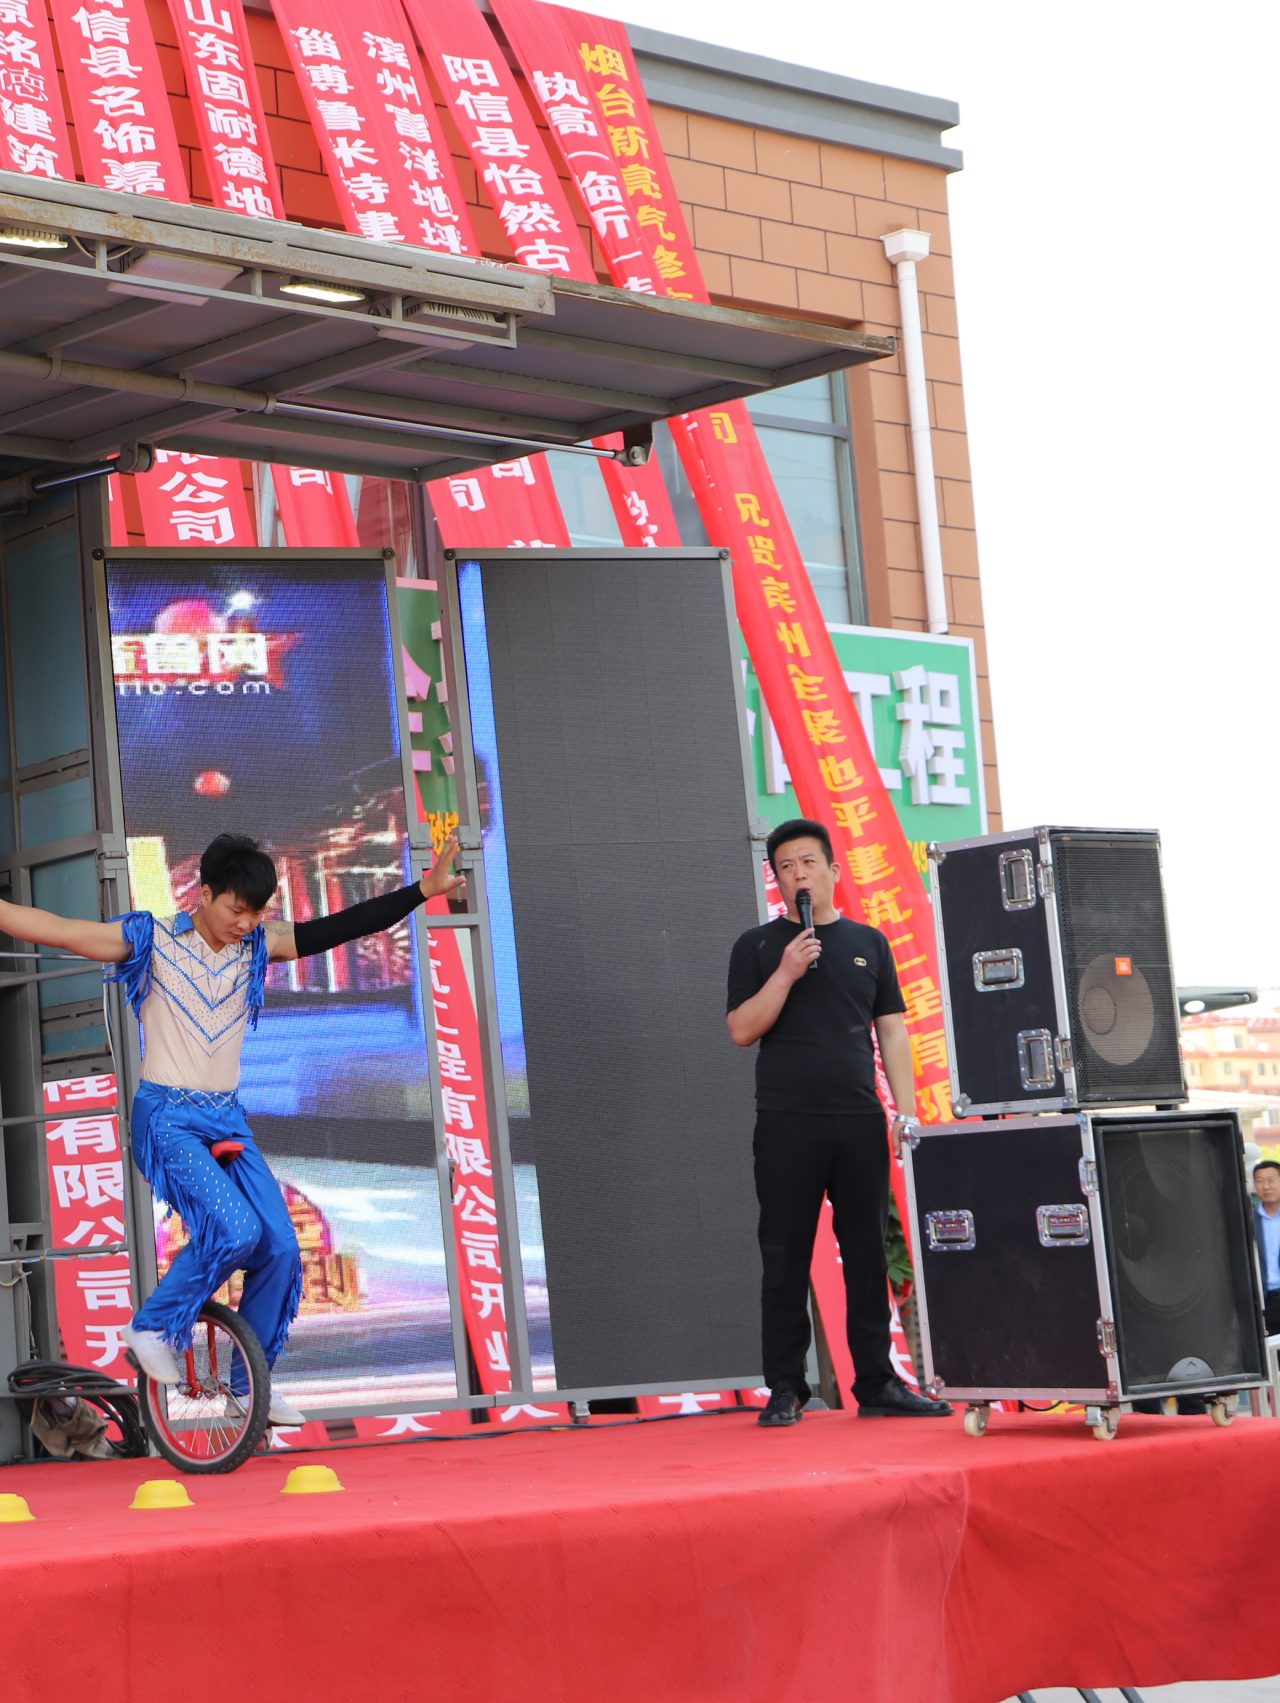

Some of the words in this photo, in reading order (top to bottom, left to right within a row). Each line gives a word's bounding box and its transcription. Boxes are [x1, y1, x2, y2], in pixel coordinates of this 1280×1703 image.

[71, 0, 166, 193] 信县名饰嘉
